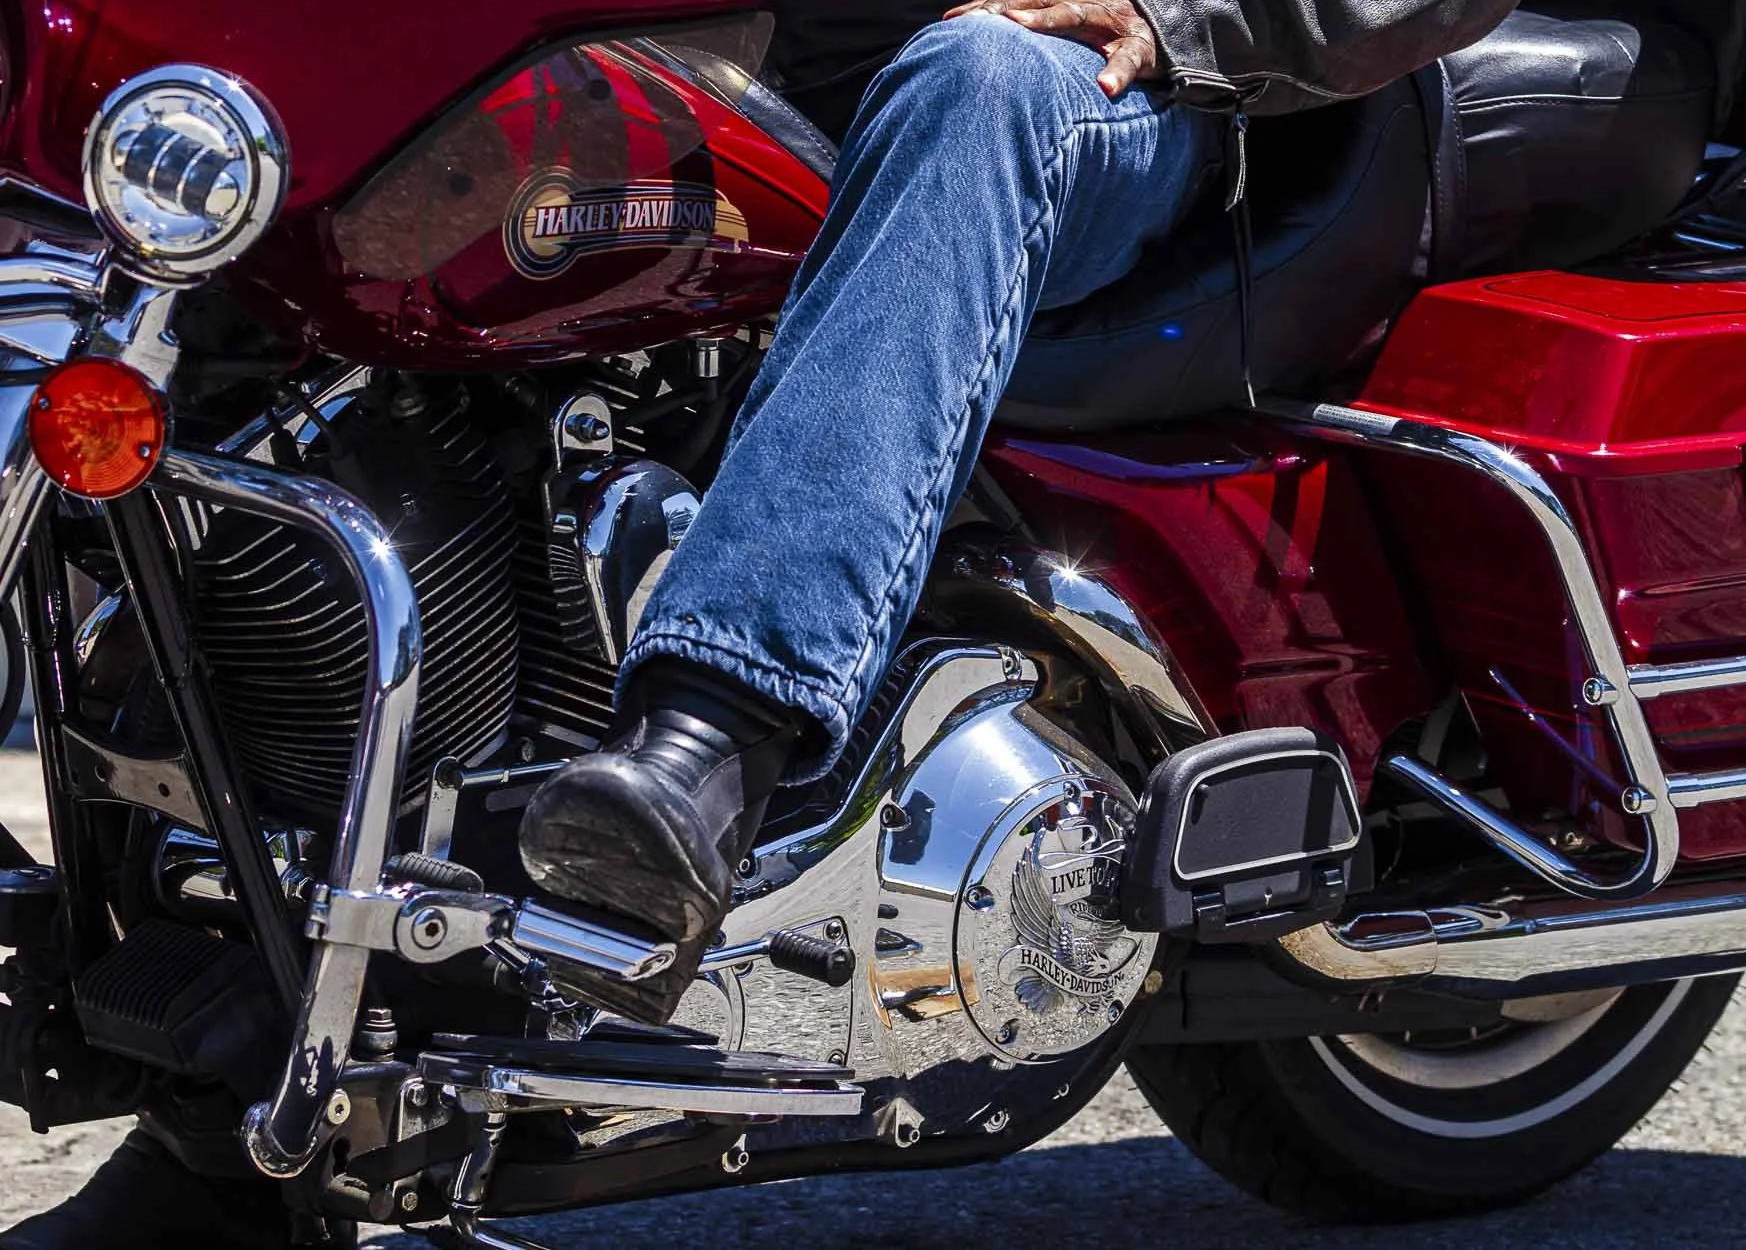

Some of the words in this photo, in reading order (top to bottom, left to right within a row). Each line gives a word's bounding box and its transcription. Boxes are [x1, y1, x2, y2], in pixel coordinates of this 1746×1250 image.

[534, 199, 714, 237] HARLEY-DAVIDSON
[1050, 868, 1085, 895] LIVE
[1086, 866, 1105, 886] TO
[1020, 948, 1122, 994] HARLEY-DAVIDSON
